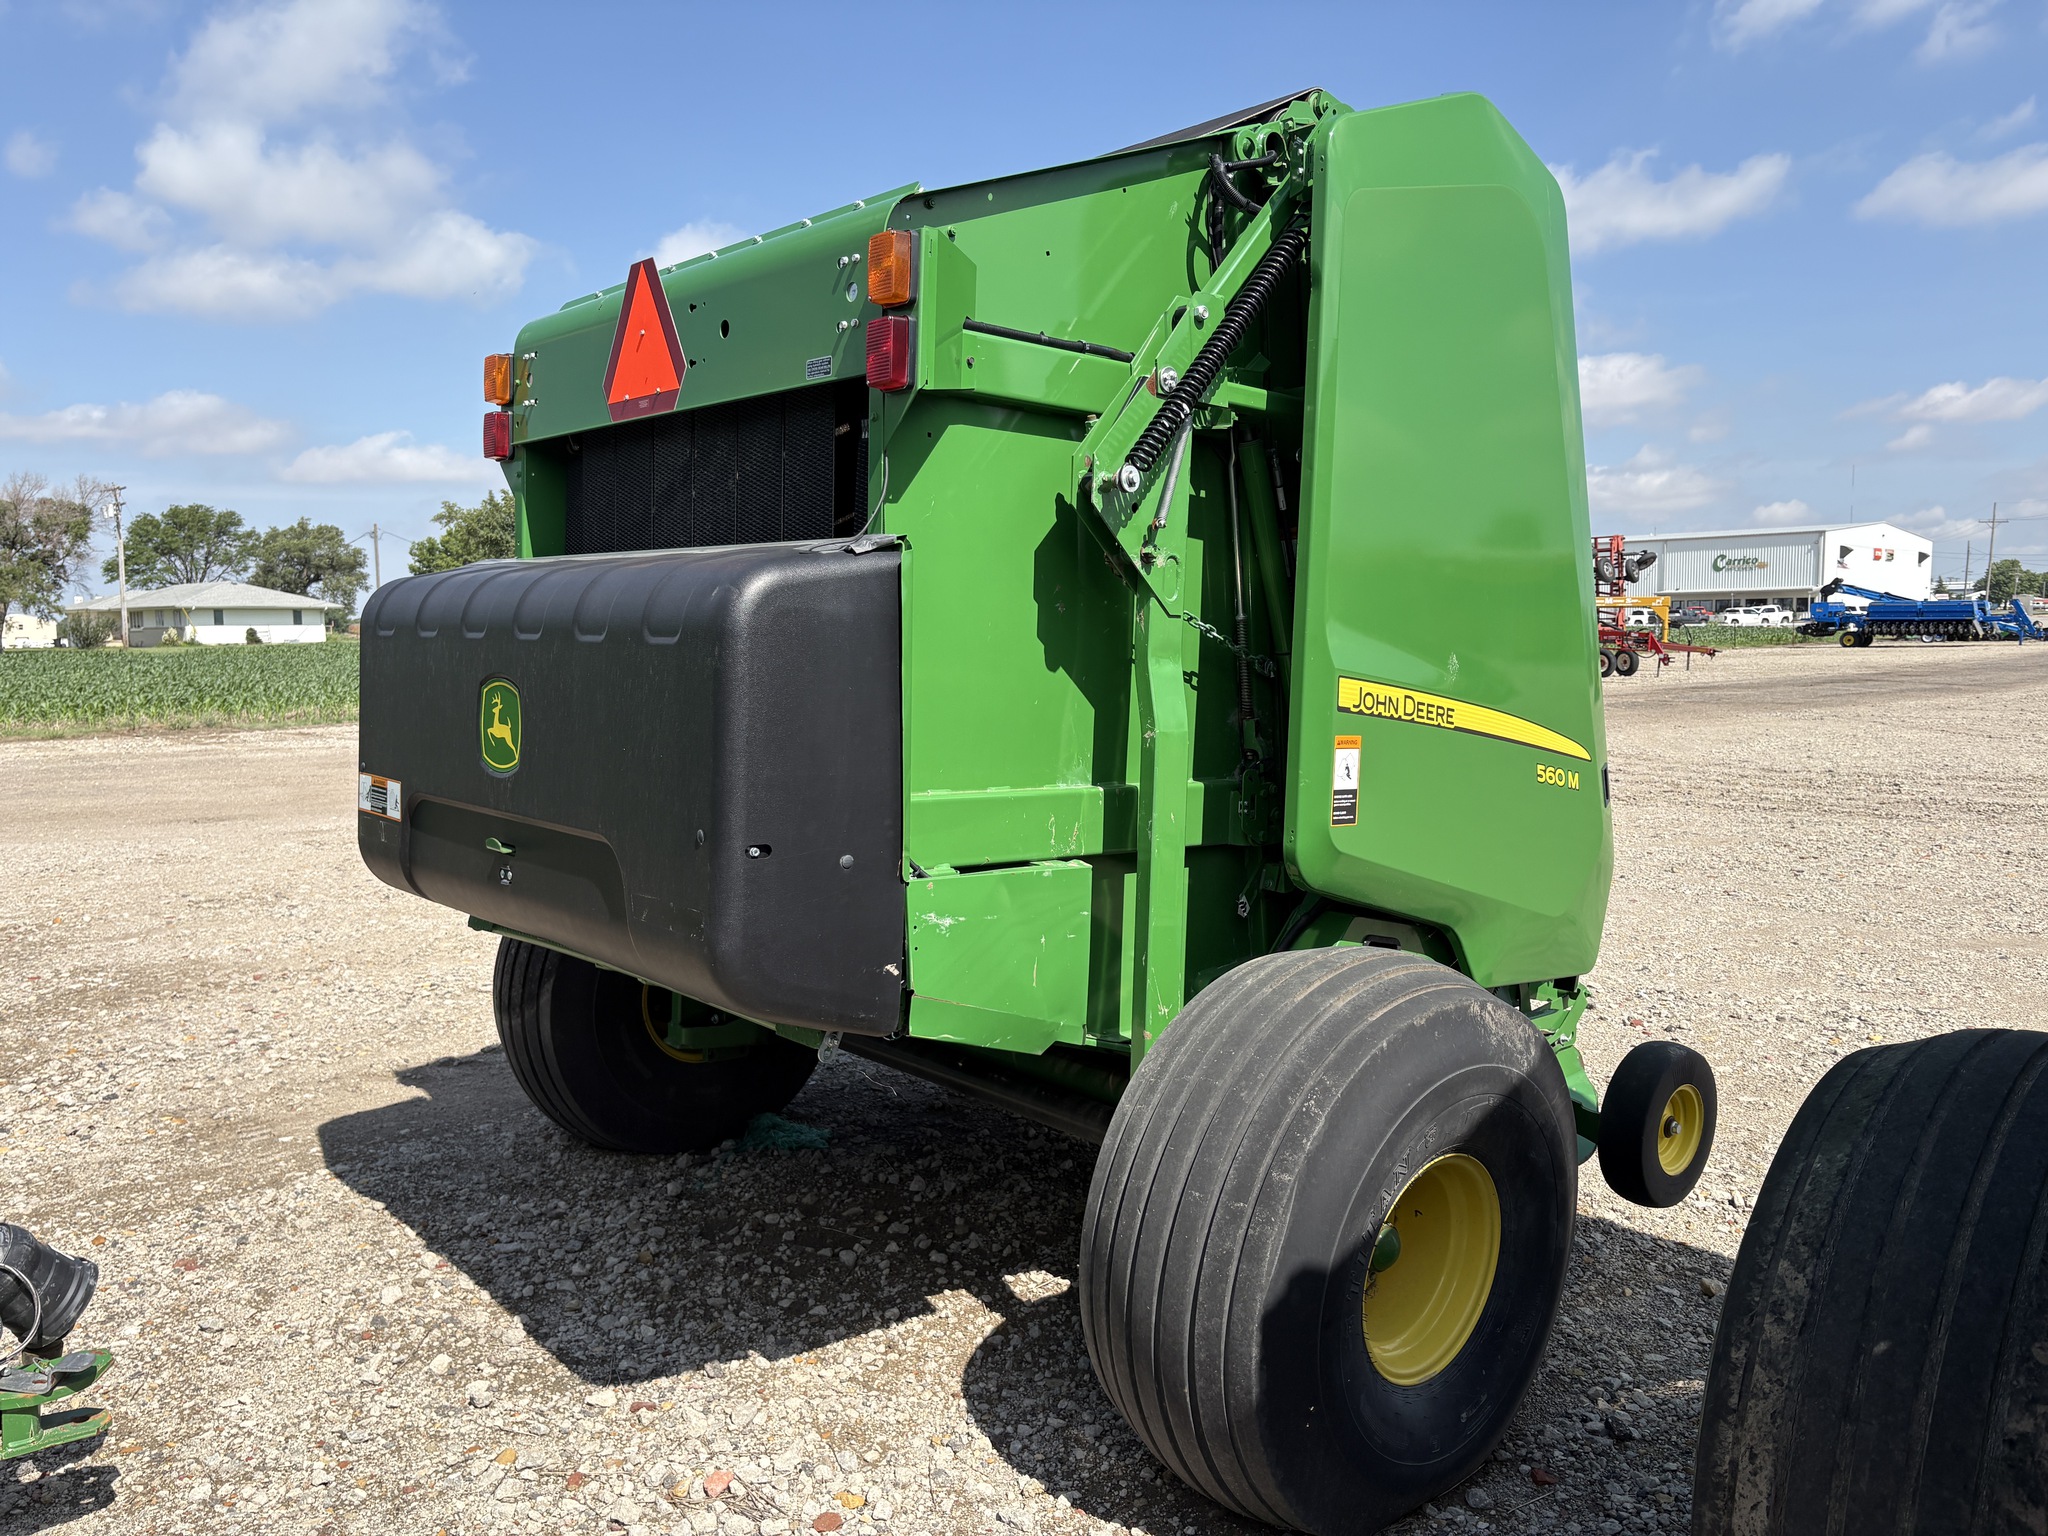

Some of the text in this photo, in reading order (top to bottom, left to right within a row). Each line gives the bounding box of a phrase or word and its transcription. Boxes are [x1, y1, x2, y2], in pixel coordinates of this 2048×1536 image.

[1713, 554, 1758, 572] Carrico
[1352, 686, 1455, 725] JOHN DEERE
[1536, 763, 1580, 791] 560 M
